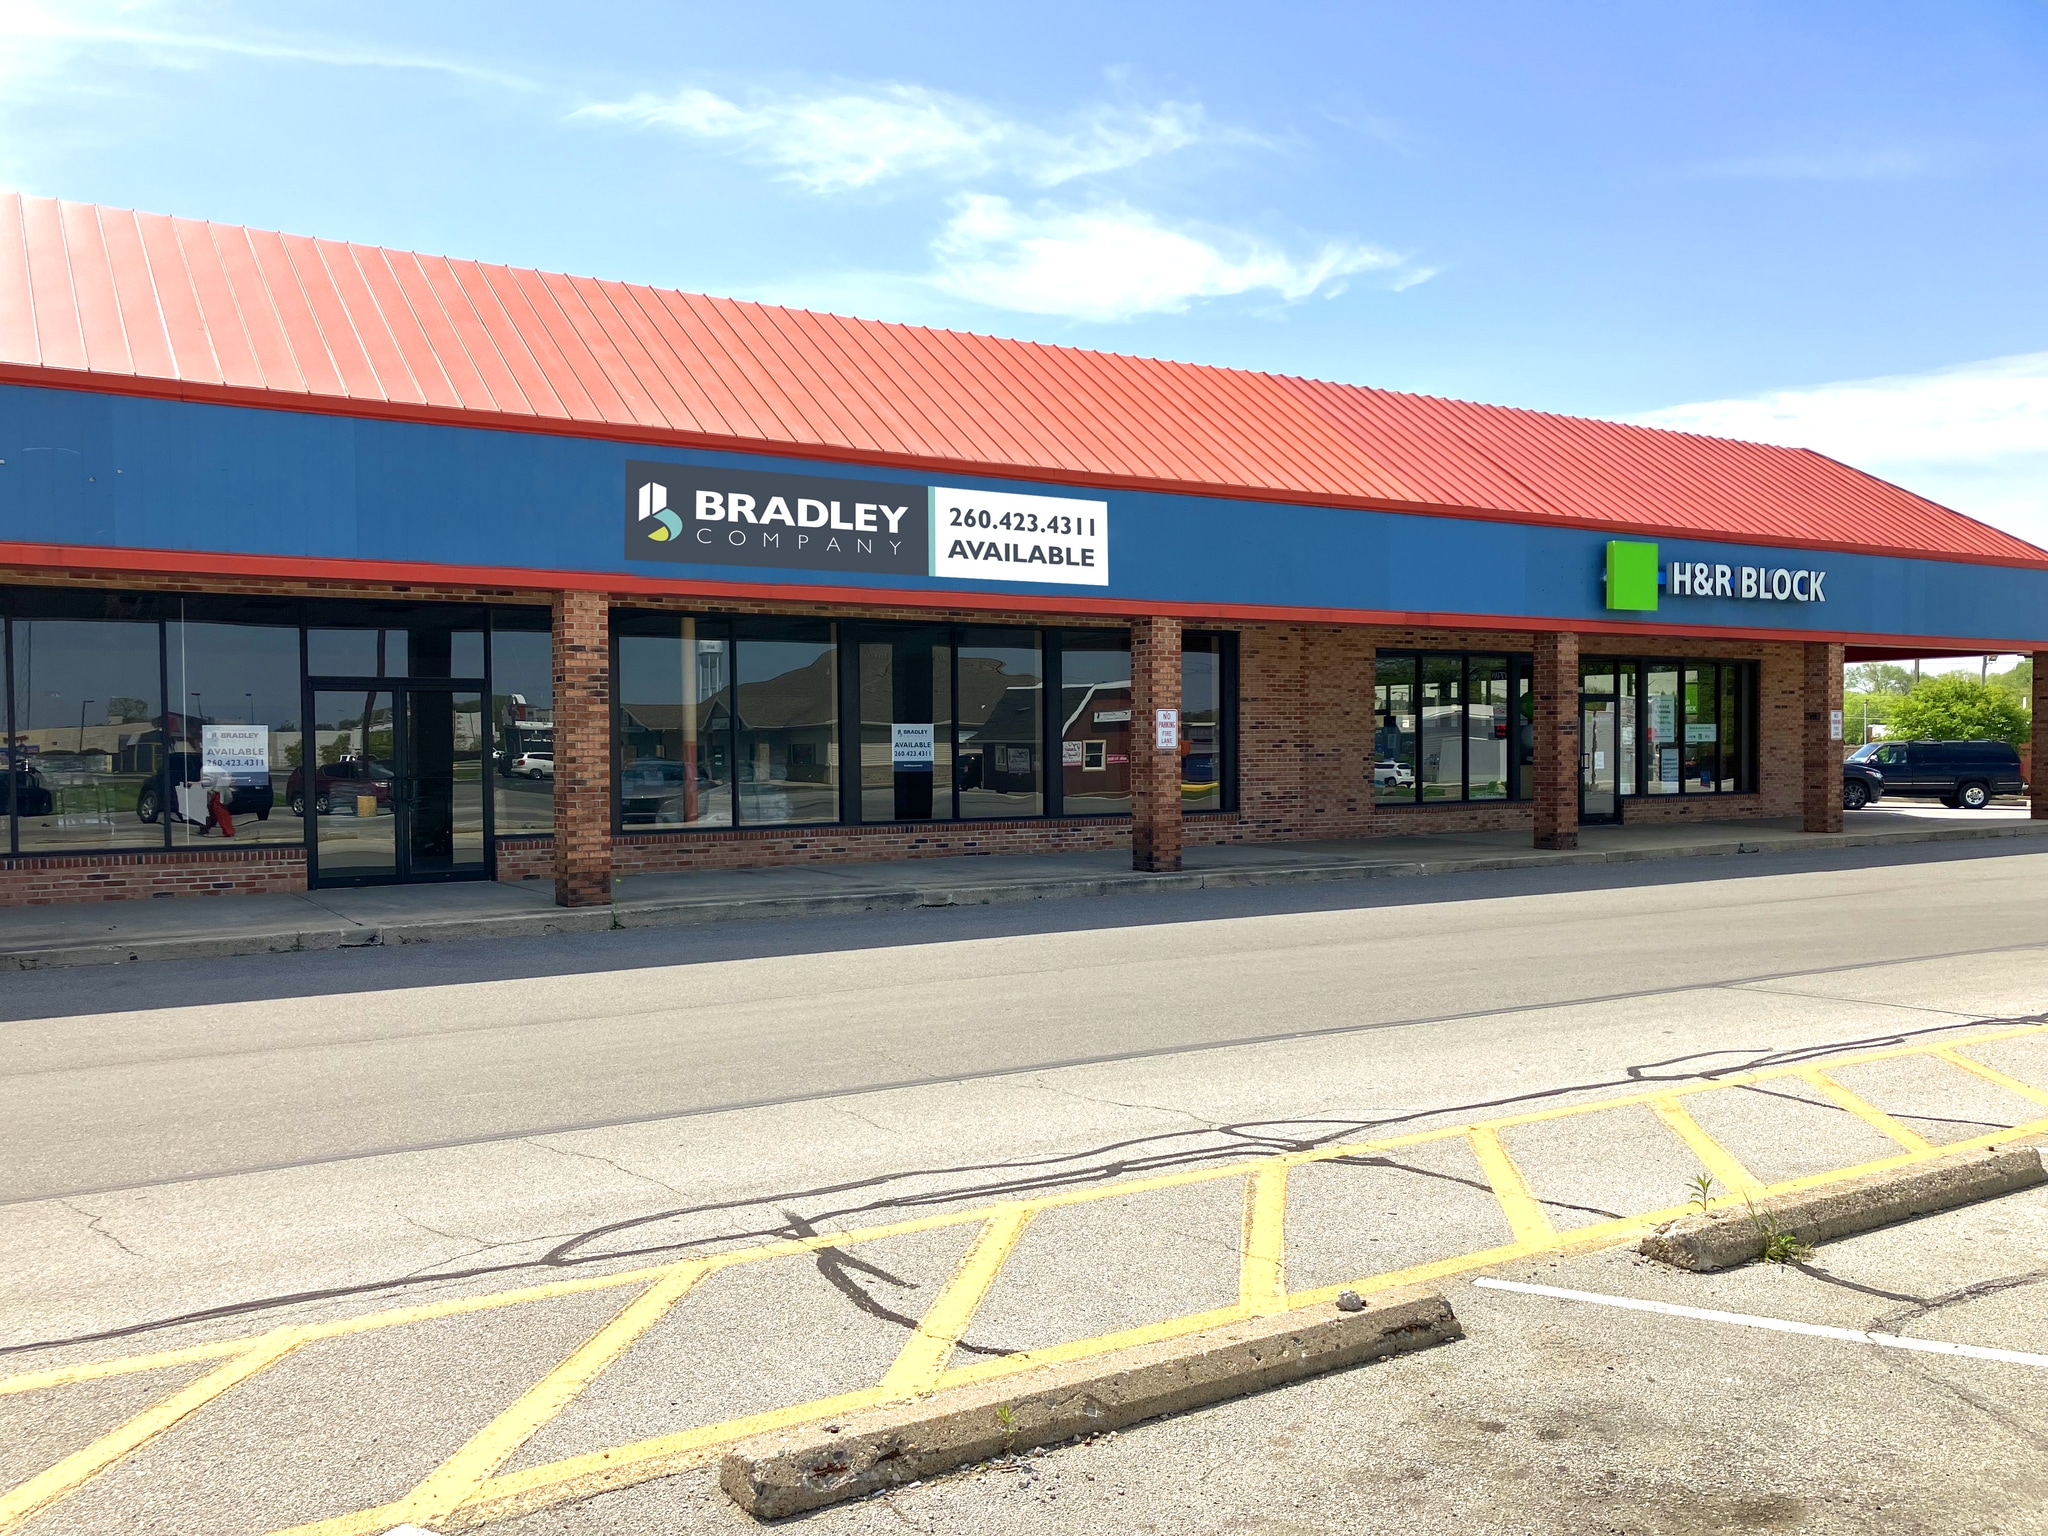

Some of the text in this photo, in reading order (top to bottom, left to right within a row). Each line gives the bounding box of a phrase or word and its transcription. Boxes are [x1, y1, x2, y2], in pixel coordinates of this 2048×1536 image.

[695, 489, 908, 534] BRADLEY
[949, 507, 1096, 537] 260.423.4311
[696, 528, 902, 555] COMPANY
[948, 540, 1095, 567] AVAILABLE
[1671, 561, 1827, 602] H&R BLOCK
